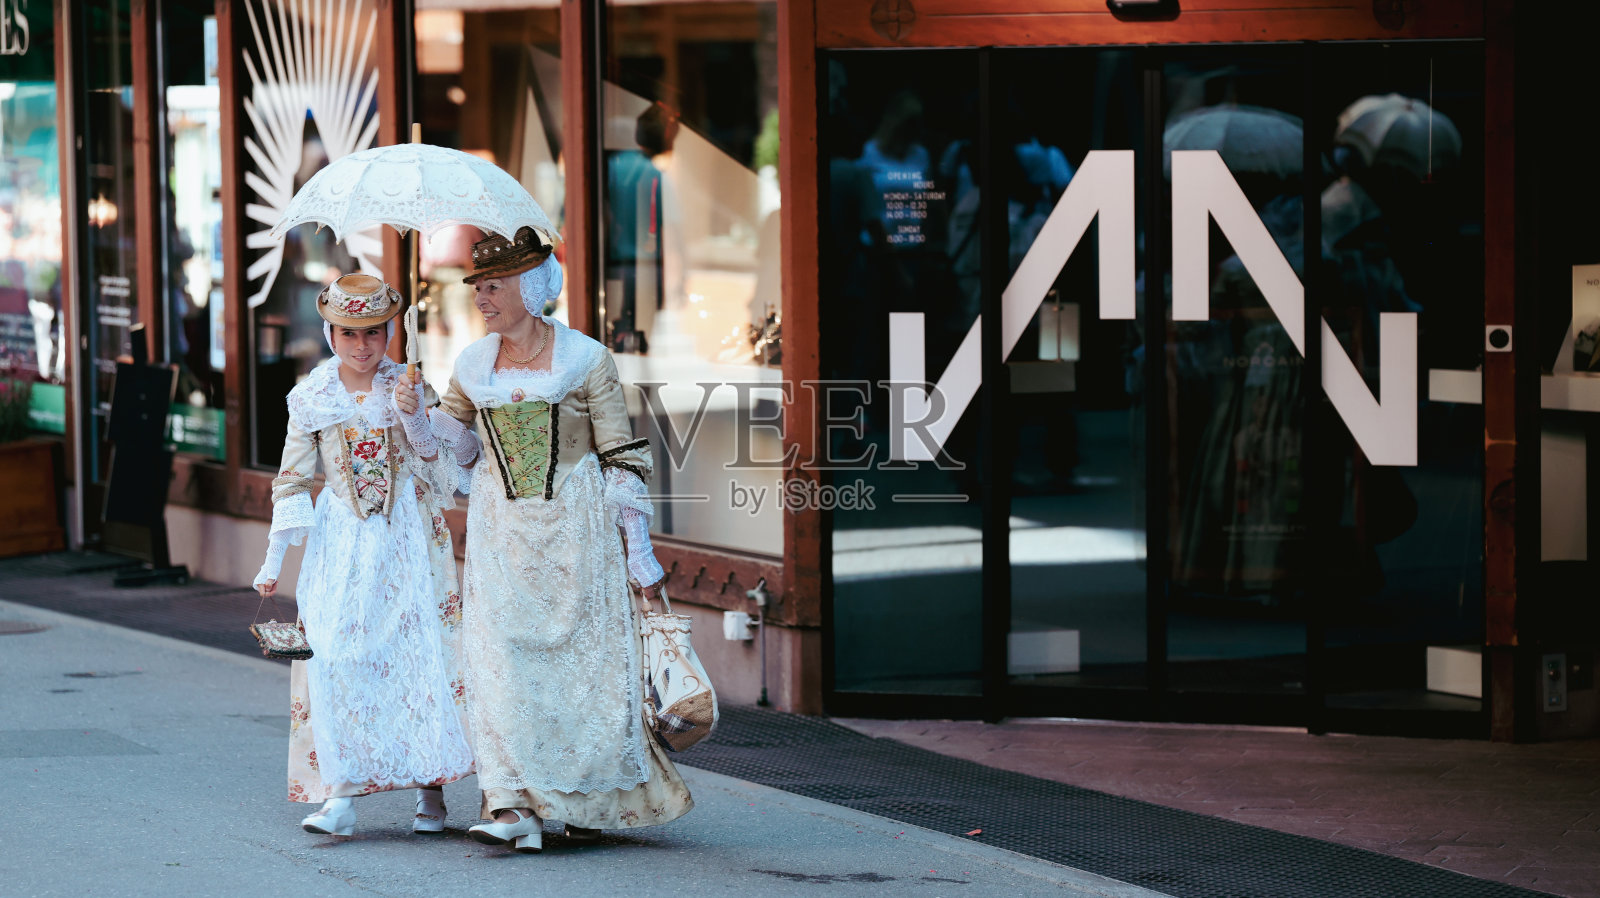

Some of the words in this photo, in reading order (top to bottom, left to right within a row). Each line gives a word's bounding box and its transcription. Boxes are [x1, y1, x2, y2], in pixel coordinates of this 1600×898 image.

[887, 171, 922, 180] OPENING
[913, 181, 934, 189] HOURS
[898, 225, 920, 234] SUNDAY
